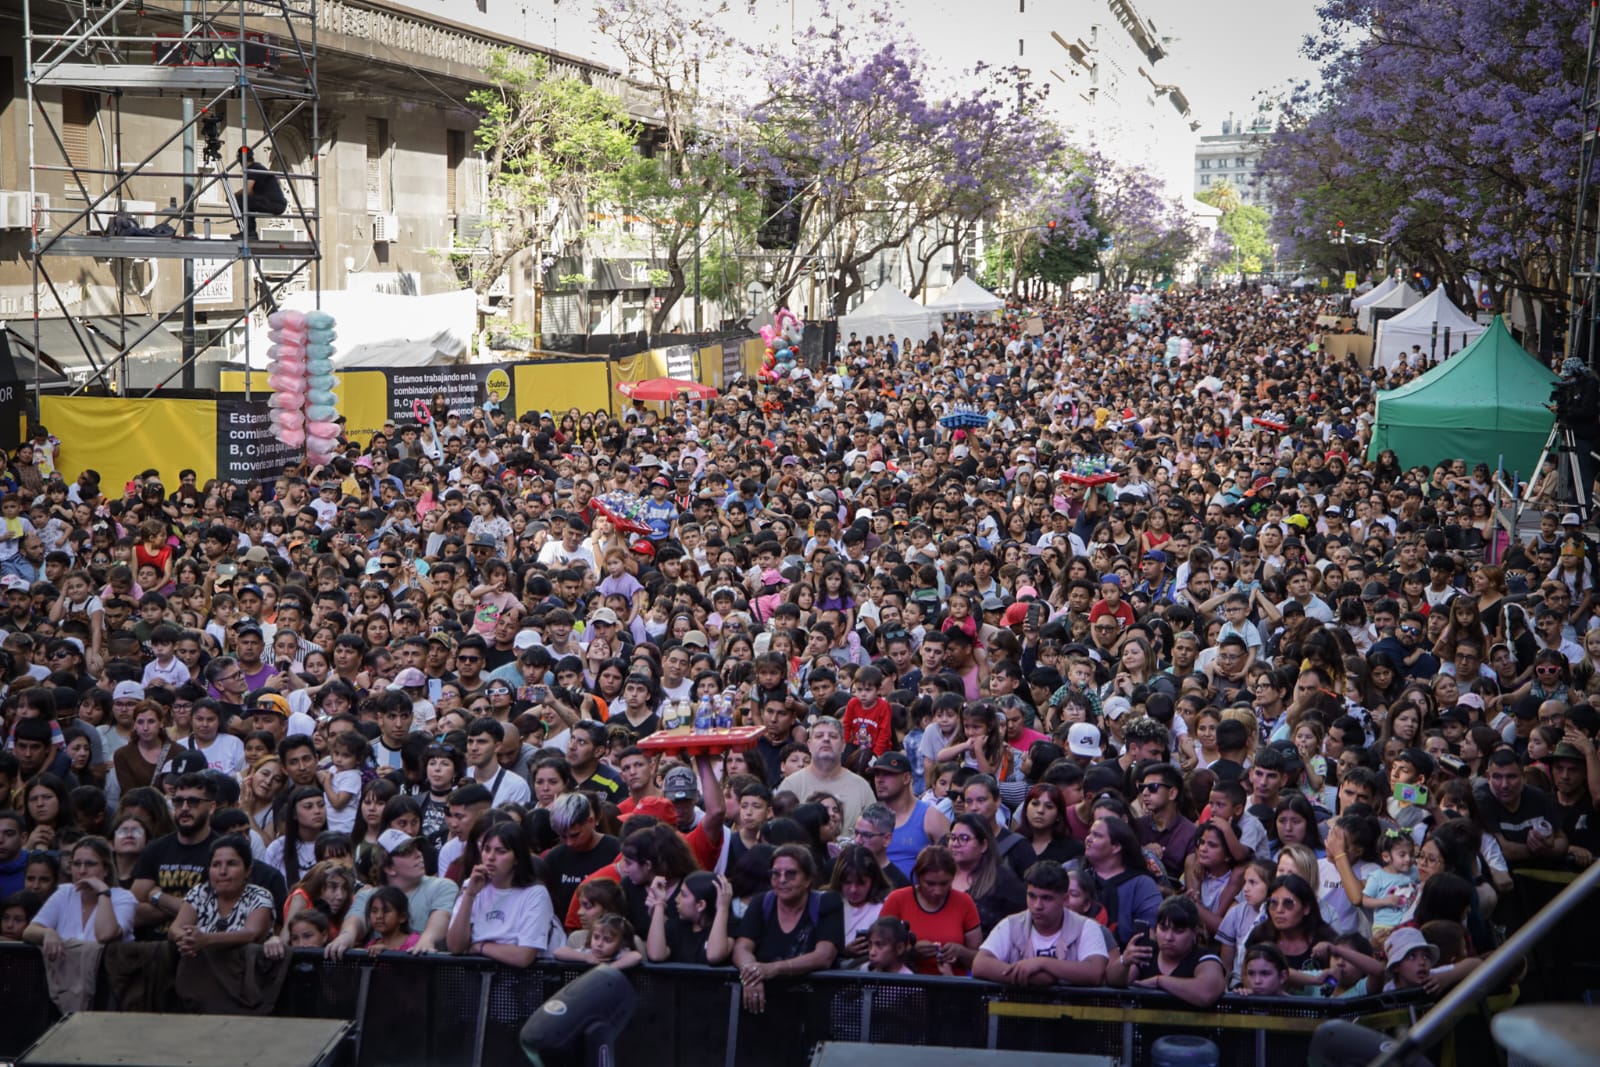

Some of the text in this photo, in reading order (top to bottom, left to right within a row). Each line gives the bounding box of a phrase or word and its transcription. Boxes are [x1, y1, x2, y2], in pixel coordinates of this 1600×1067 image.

[393, 375, 423, 384] Estamos
[424, 373, 460, 384] trabajando
[469, 372, 477, 381] la
[448, 384, 458, 393] las
[402, 398, 409, 407] C
[229, 444, 243, 457] B,
[246, 444, 256, 456] C
